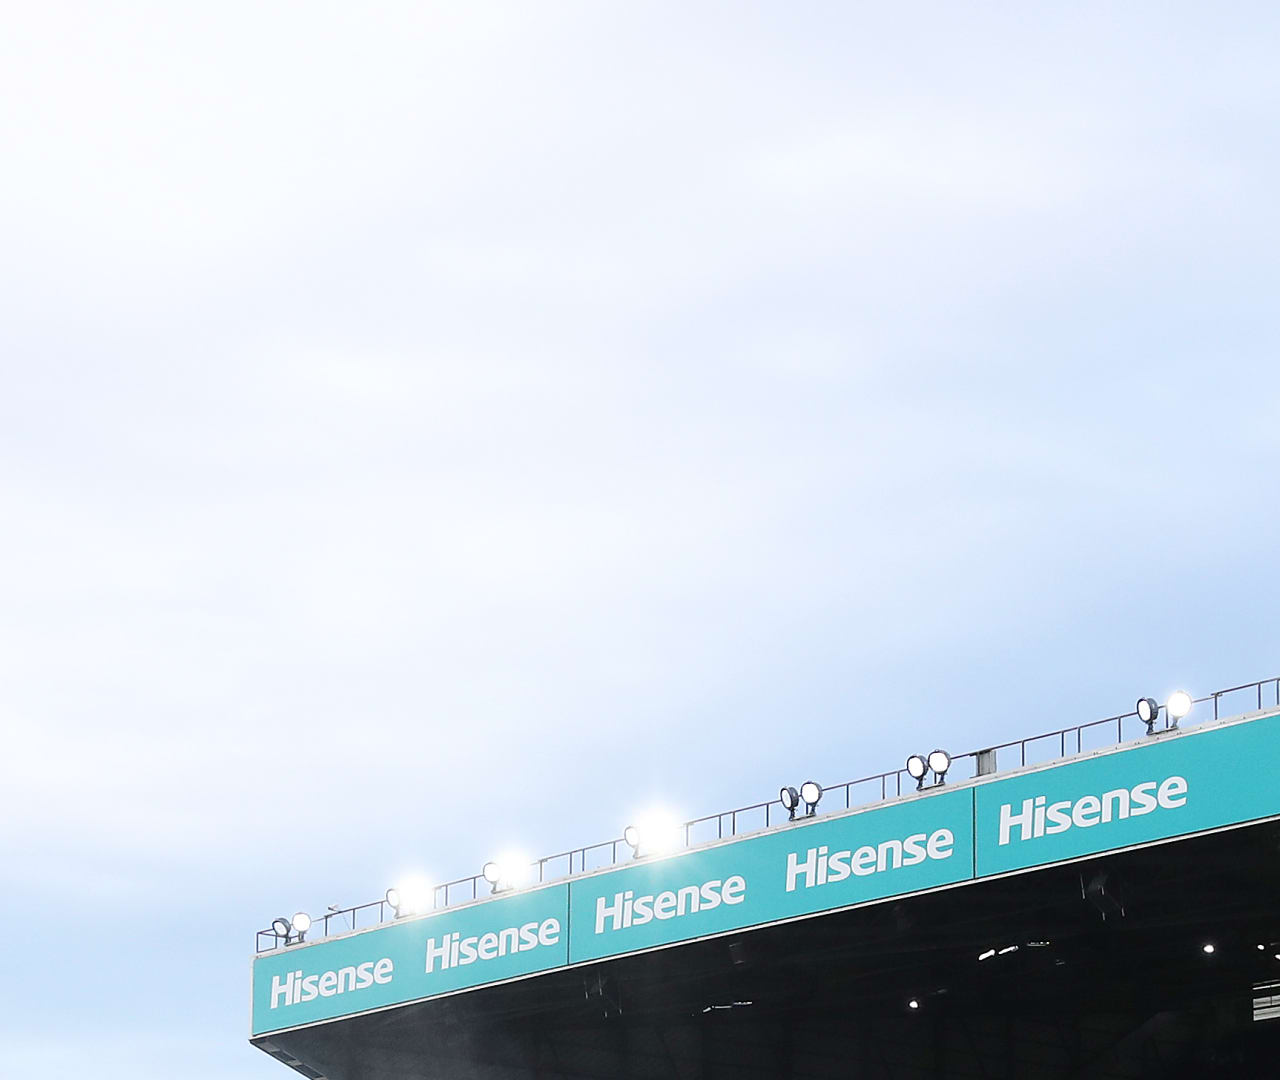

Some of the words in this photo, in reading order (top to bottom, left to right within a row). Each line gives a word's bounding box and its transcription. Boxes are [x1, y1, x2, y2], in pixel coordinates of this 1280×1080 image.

[999, 776, 1187, 845] Hisense
[786, 829, 953, 892] Hisense
[595, 875, 746, 933] Hisense
[425, 918, 561, 974] Hisense
[270, 958, 393, 1009] Hisense
